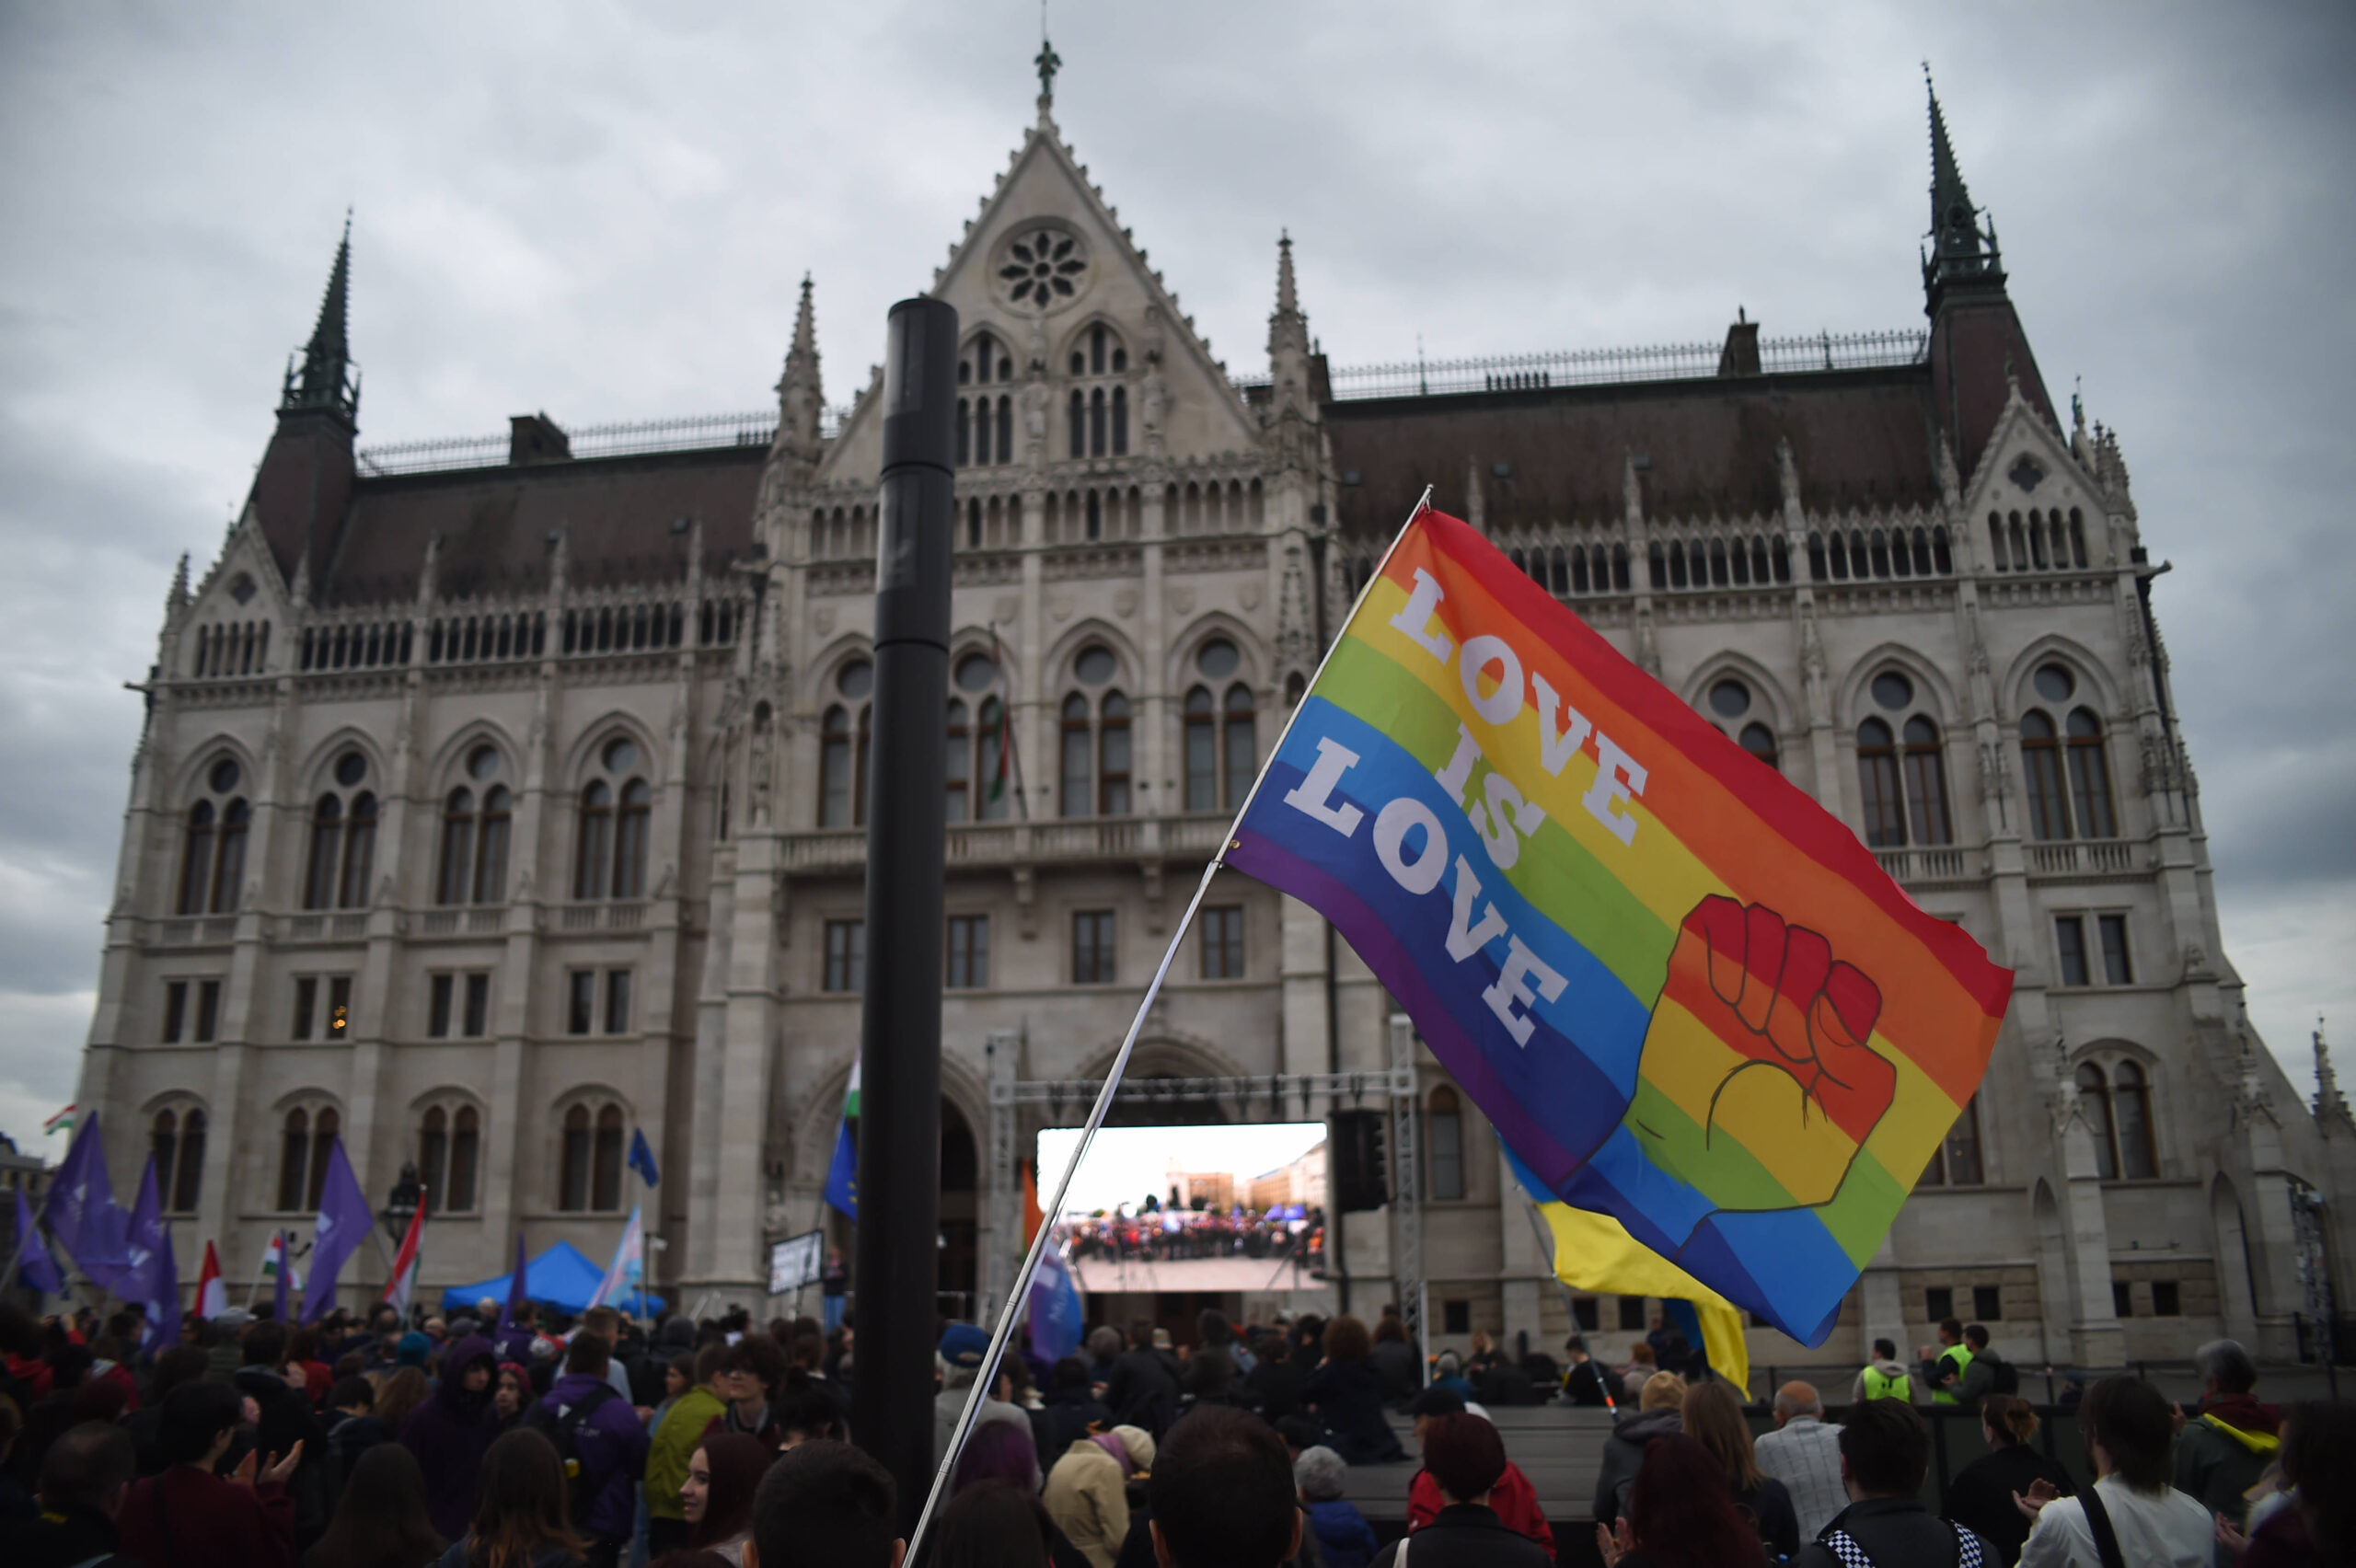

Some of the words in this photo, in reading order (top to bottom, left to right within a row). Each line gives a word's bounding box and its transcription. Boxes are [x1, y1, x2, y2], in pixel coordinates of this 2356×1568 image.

[1389, 567, 1649, 847] LOVE
[1433, 721, 1547, 870] IS
[1283, 736, 1570, 1048] LOVE
